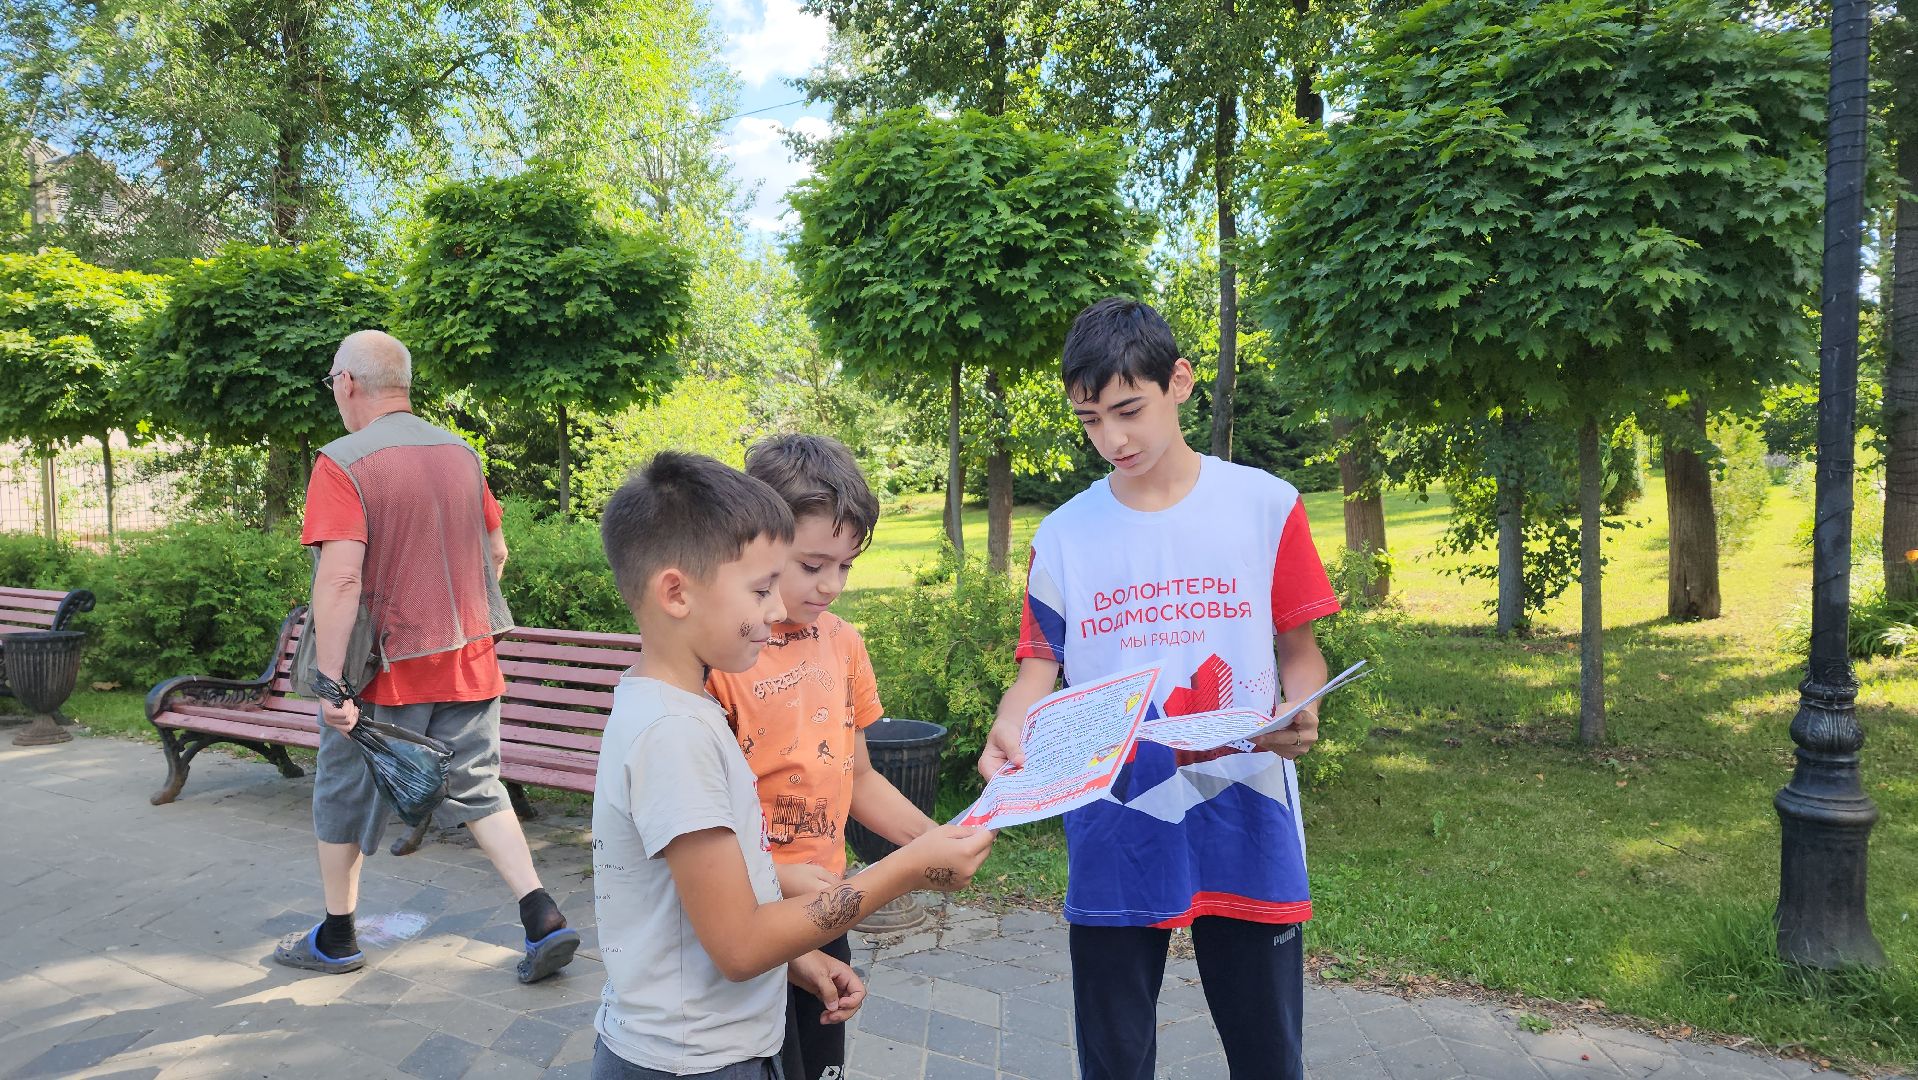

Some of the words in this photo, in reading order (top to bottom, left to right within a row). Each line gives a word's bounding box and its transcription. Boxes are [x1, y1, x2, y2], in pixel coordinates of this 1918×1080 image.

[1093, 577, 1236, 612] ВОЛОНТЕРЫ
[1080, 601, 1252, 639] ПОДМОСКОВЬЯ
[1120, 634, 1147, 651] МЫ
[1151, 629, 1205, 647] РЯДОМ
[1273, 926, 1296, 947] PUMA
